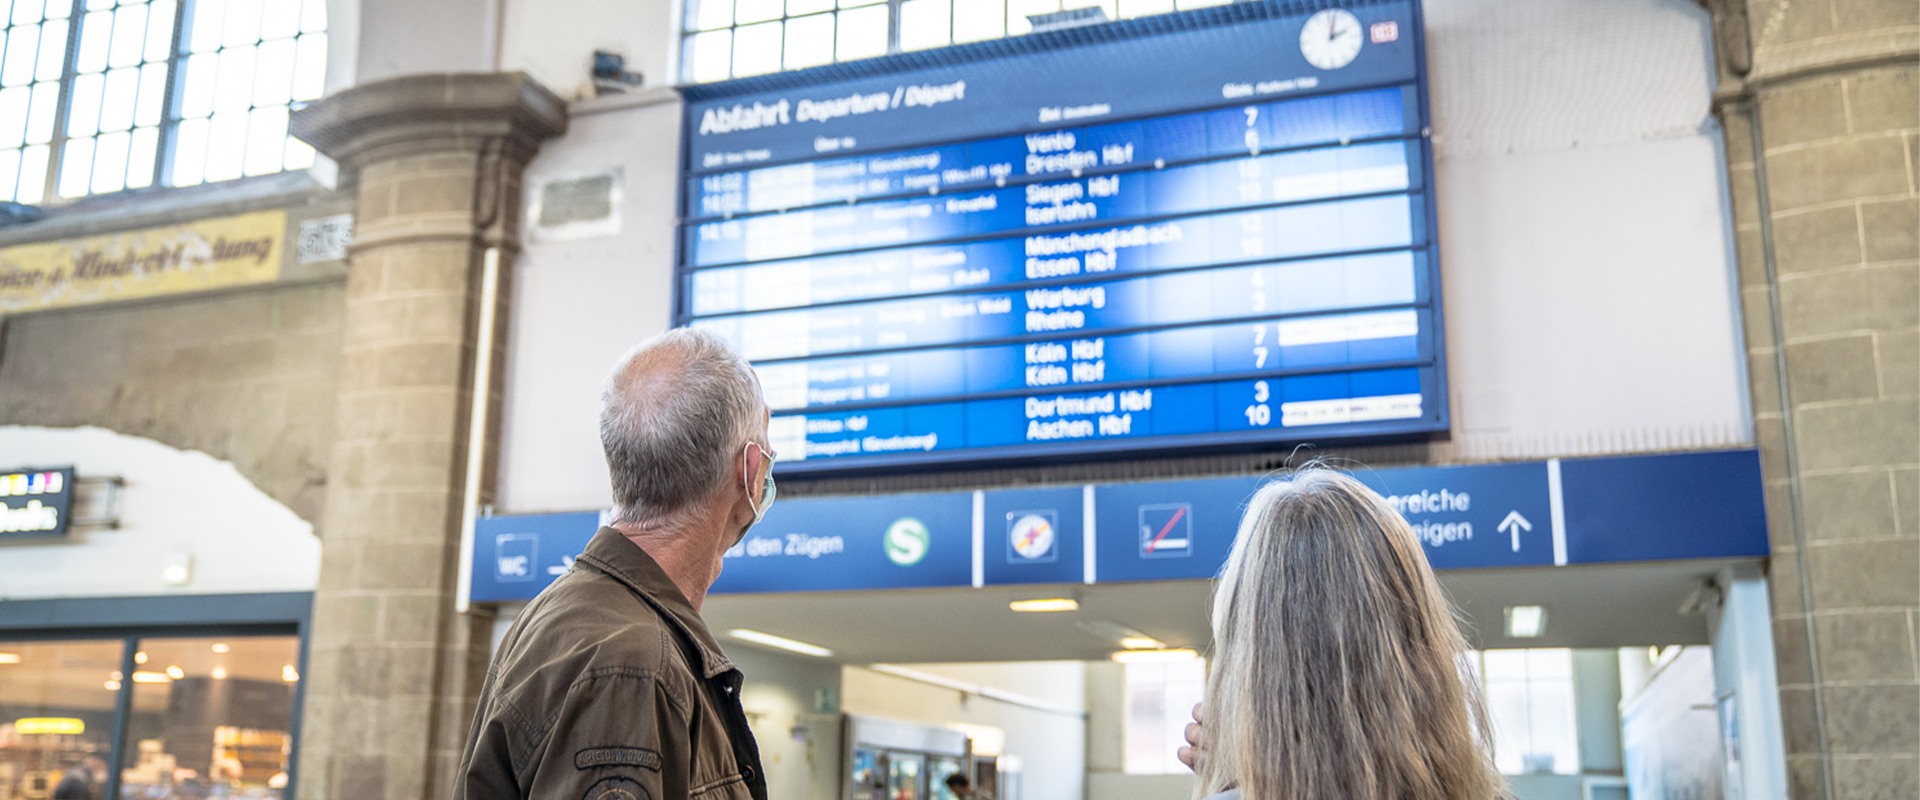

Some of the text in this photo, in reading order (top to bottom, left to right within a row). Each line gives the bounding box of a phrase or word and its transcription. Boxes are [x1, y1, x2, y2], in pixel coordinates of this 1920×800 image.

[699, 98, 790, 136] Abfahrt
[795, 90, 892, 123] Departure
[904, 79, 967, 108] Départ
[1243, 106, 1259, 128] 7
[1025, 130, 1076, 154] Venlo
[1025, 141, 1134, 175] Dresden Hbf
[1025, 174, 1120, 207] Siegen Hbf
[1025, 200, 1097, 227] Iserlohn
[1025, 220, 1183, 258] Mönchengladbach
[1025, 250, 1118, 280] Essen Hbf
[1025, 284, 1106, 311] Warburg
[1025, 308, 1086, 334] Rheine
[1252, 325, 1269, 347] 7
[1025, 336, 1105, 366] Köln Hbf
[1253, 346, 1270, 369] 7
[1025, 360, 1105, 387] Köln Hbf
[1025, 387, 1152, 419] Dortmund Hbf
[1254, 380, 1270, 403] 3
[1026, 412, 1132, 441] Aachen Hbf
[1244, 404, 1271, 427] 10
[745, 534, 783, 558] den
[784, 533, 844, 560] Zügen
[889, 517, 925, 565] S
[497, 555, 528, 577] WC
